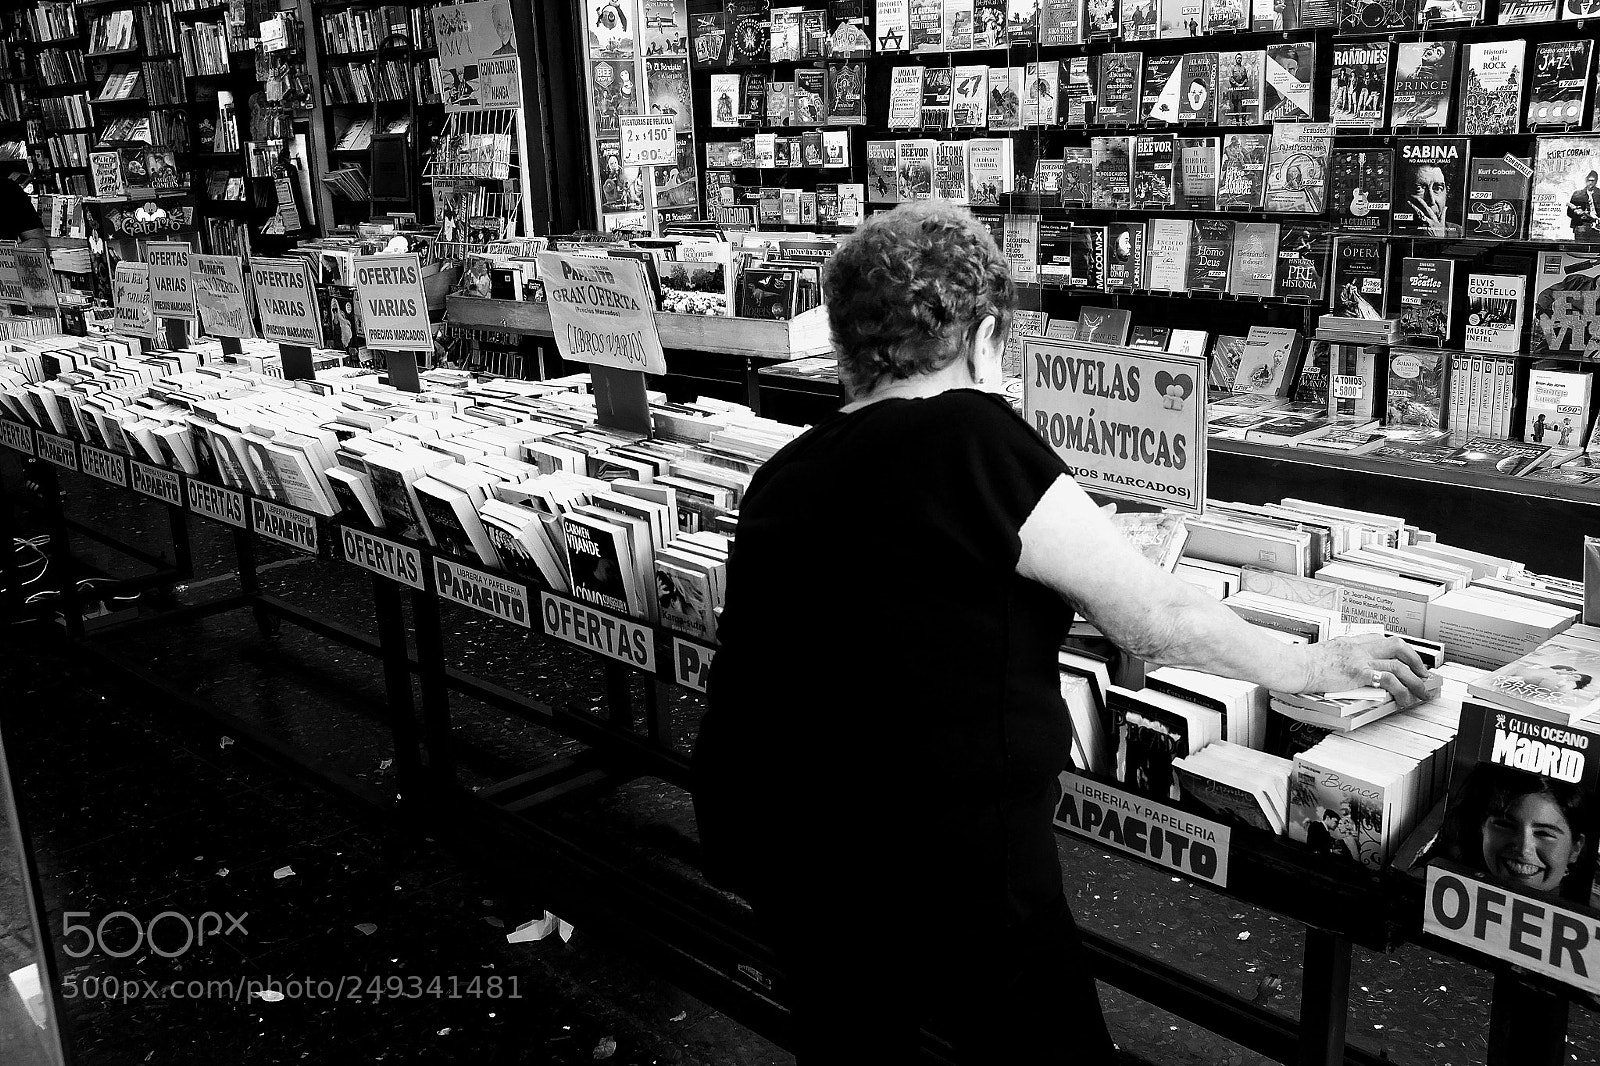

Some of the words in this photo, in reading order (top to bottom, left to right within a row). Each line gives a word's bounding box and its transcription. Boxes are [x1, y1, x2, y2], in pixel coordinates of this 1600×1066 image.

[1334, 50, 1387, 65] RAMONES
[1484, 48, 1508, 56] Historia
[1483, 62, 1507, 70] ROCK
[1538, 56, 1570, 71] JAZZ
[597, 68, 611, 76] BEE
[1396, 81, 1448, 91] PRINCE
[626, 129, 633, 142] 2
[868, 148, 895, 159] BEEVOR
[900, 147, 929, 157] BEEVOR
[936, 143, 963, 156] ANTONY
[1137, 141, 1172, 153] BEEVOR
[1403, 145, 1459, 159] SABINA
[1547, 149, 1566, 160] KURT
[1566, 148, 1590, 157] COBAIN
[1095, 231, 1103, 242] X
[1198, 245, 1225, 257] Homo
[1343, 245, 1380, 258] ÓPERA
[150, 251, 188, 267] OFERTAS
[1095, 243, 1103, 289] MALCOLM
[1199, 256, 1220, 267] Deus
[255, 270, 304, 289] OFERTAS
[358, 266, 417, 286] OFERTAS
[1287, 266, 1313, 280] PRE
[154, 276, 187, 293] VARIAS
[1282, 279, 1317, 289] HISTORIA
[1409, 276, 1442, 288] Beatles
[1470, 278, 1495, 287] ELVIS
[552, 285, 587, 305] GRAN
[587, 284, 641, 311] OFERTA
[1469, 286, 1517, 297] COSTELLO
[116, 306, 140, 320] POLICIAL
[264, 298, 306, 317] VARIAS
[368, 298, 417, 317] VARIAS
[575, 305, 595, 316] (Precios
[368, 328, 393, 342] (PRECIOS
[394, 329, 426, 343] MARCADOS)
[1467, 326, 1498, 336] MÚSICA
[567, 323, 605, 356] LIBROS
[606, 330, 647, 367] VARIOS
[1466, 335, 1493, 343] INFIEL
[1034, 352, 1141, 402] NOVELAS
[1340, 376, 1362, 386] TOMOS
[1536, 387, 1569, 397] George
[1034, 408, 1187, 470] ROMÁNTICAS
[82, 446, 123, 483] OFERTAS
[132, 463, 179, 502] PAPACITO
[1102, 472, 1191, 500] MARCADOS)
[189, 480, 242, 522] OFERTAS
[253, 501, 315, 549] PAPACITO
[564, 521, 591, 540] CARMEN
[566, 533, 602, 558] VIJANDE
[344, 530, 418, 583] OFERTAS
[457, 567, 482, 583] LIBRERIA
[488, 579, 522, 597] PAPELERIA
[436, 560, 525, 622] PAPACITO
[1351, 607, 1379, 621] FAMILIAR
[1379, 613, 1388, 623] DE
[1388, 615, 1400, 625] LOS
[544, 597, 648, 666] OFERTAS
[1385, 623, 1408, 635] CUIDAN
[1508, 718, 1540, 737] GUIAS
[1540, 725, 1589, 750] OCEANO
[1320, 773, 1380, 800] Bianca
[1074, 781, 1132, 810] LIBRERIA
[1133, 804, 1142, 815] Y
[1145, 808, 1216, 842] PAPELERIA
[1055, 793, 1218, 880] APACITO
[1432, 875, 1600, 979] OFER
